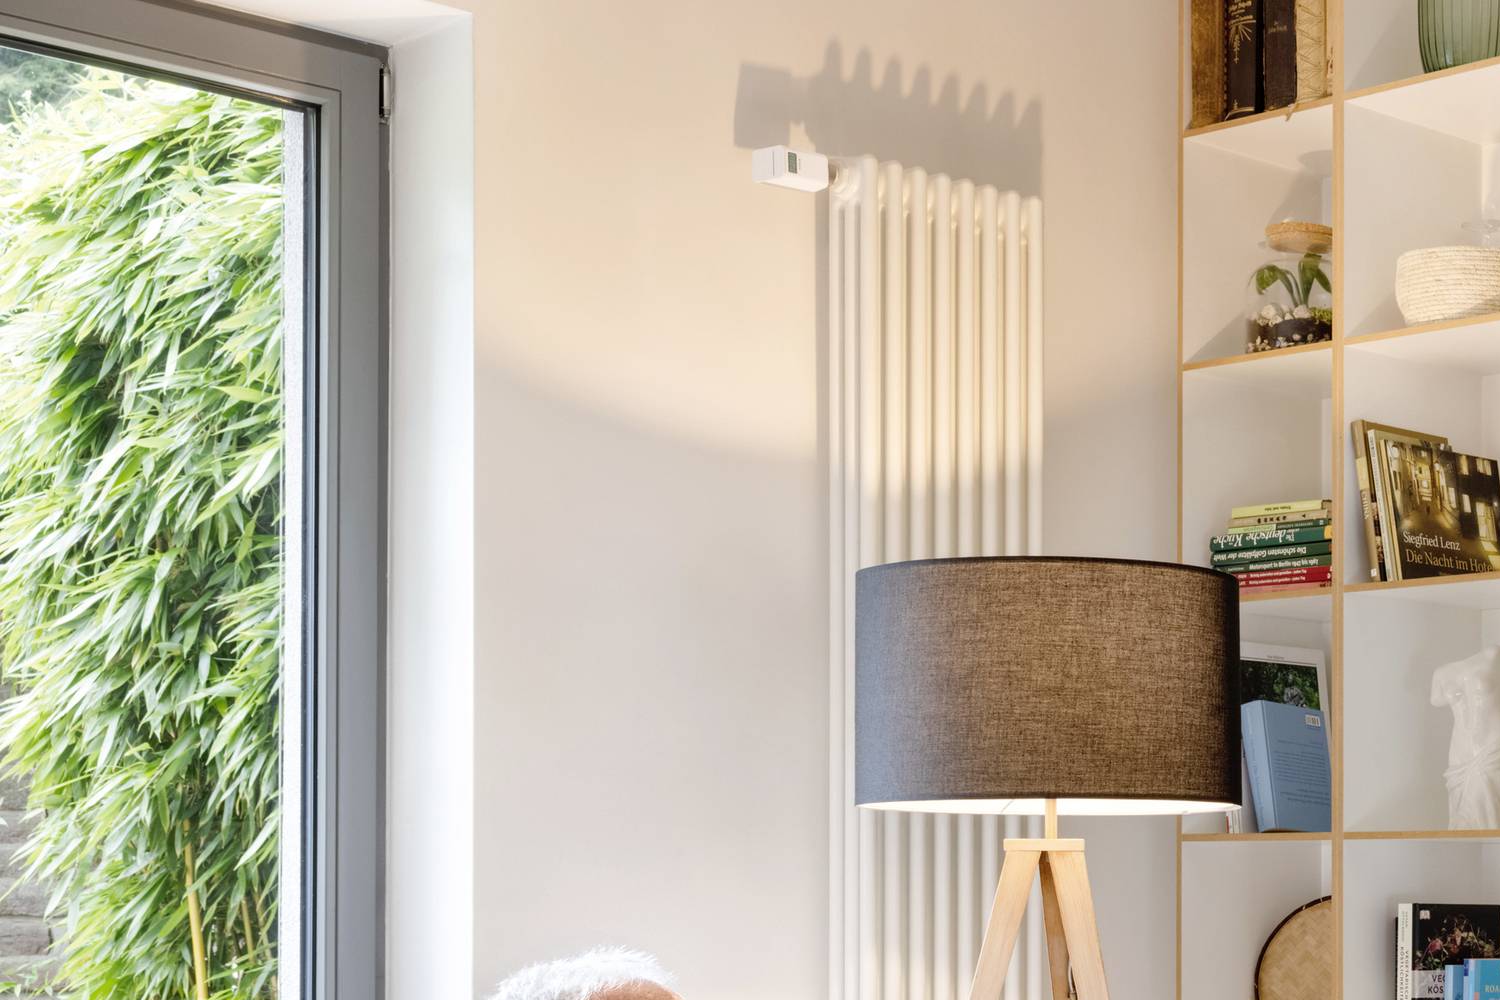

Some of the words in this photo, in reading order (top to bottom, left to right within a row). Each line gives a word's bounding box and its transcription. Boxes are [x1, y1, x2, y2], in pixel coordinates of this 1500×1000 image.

[1213, 534, 1242, 548] Küche
[1245, 529, 1286, 546] deutsche
[1402, 531, 1439, 548] Siegfried
[1439, 536, 1461, 551] Lenz
[1267, 547, 1296, 557] schönsten
[1296, 546, 1307, 554] Die
[1213, 554, 1227, 562] Welt
[1227, 553, 1237, 561] der
[1406, 549, 1423, 564] Die
[1425, 553, 1453, 568] Nacht
[1455, 559, 1468, 570] im
